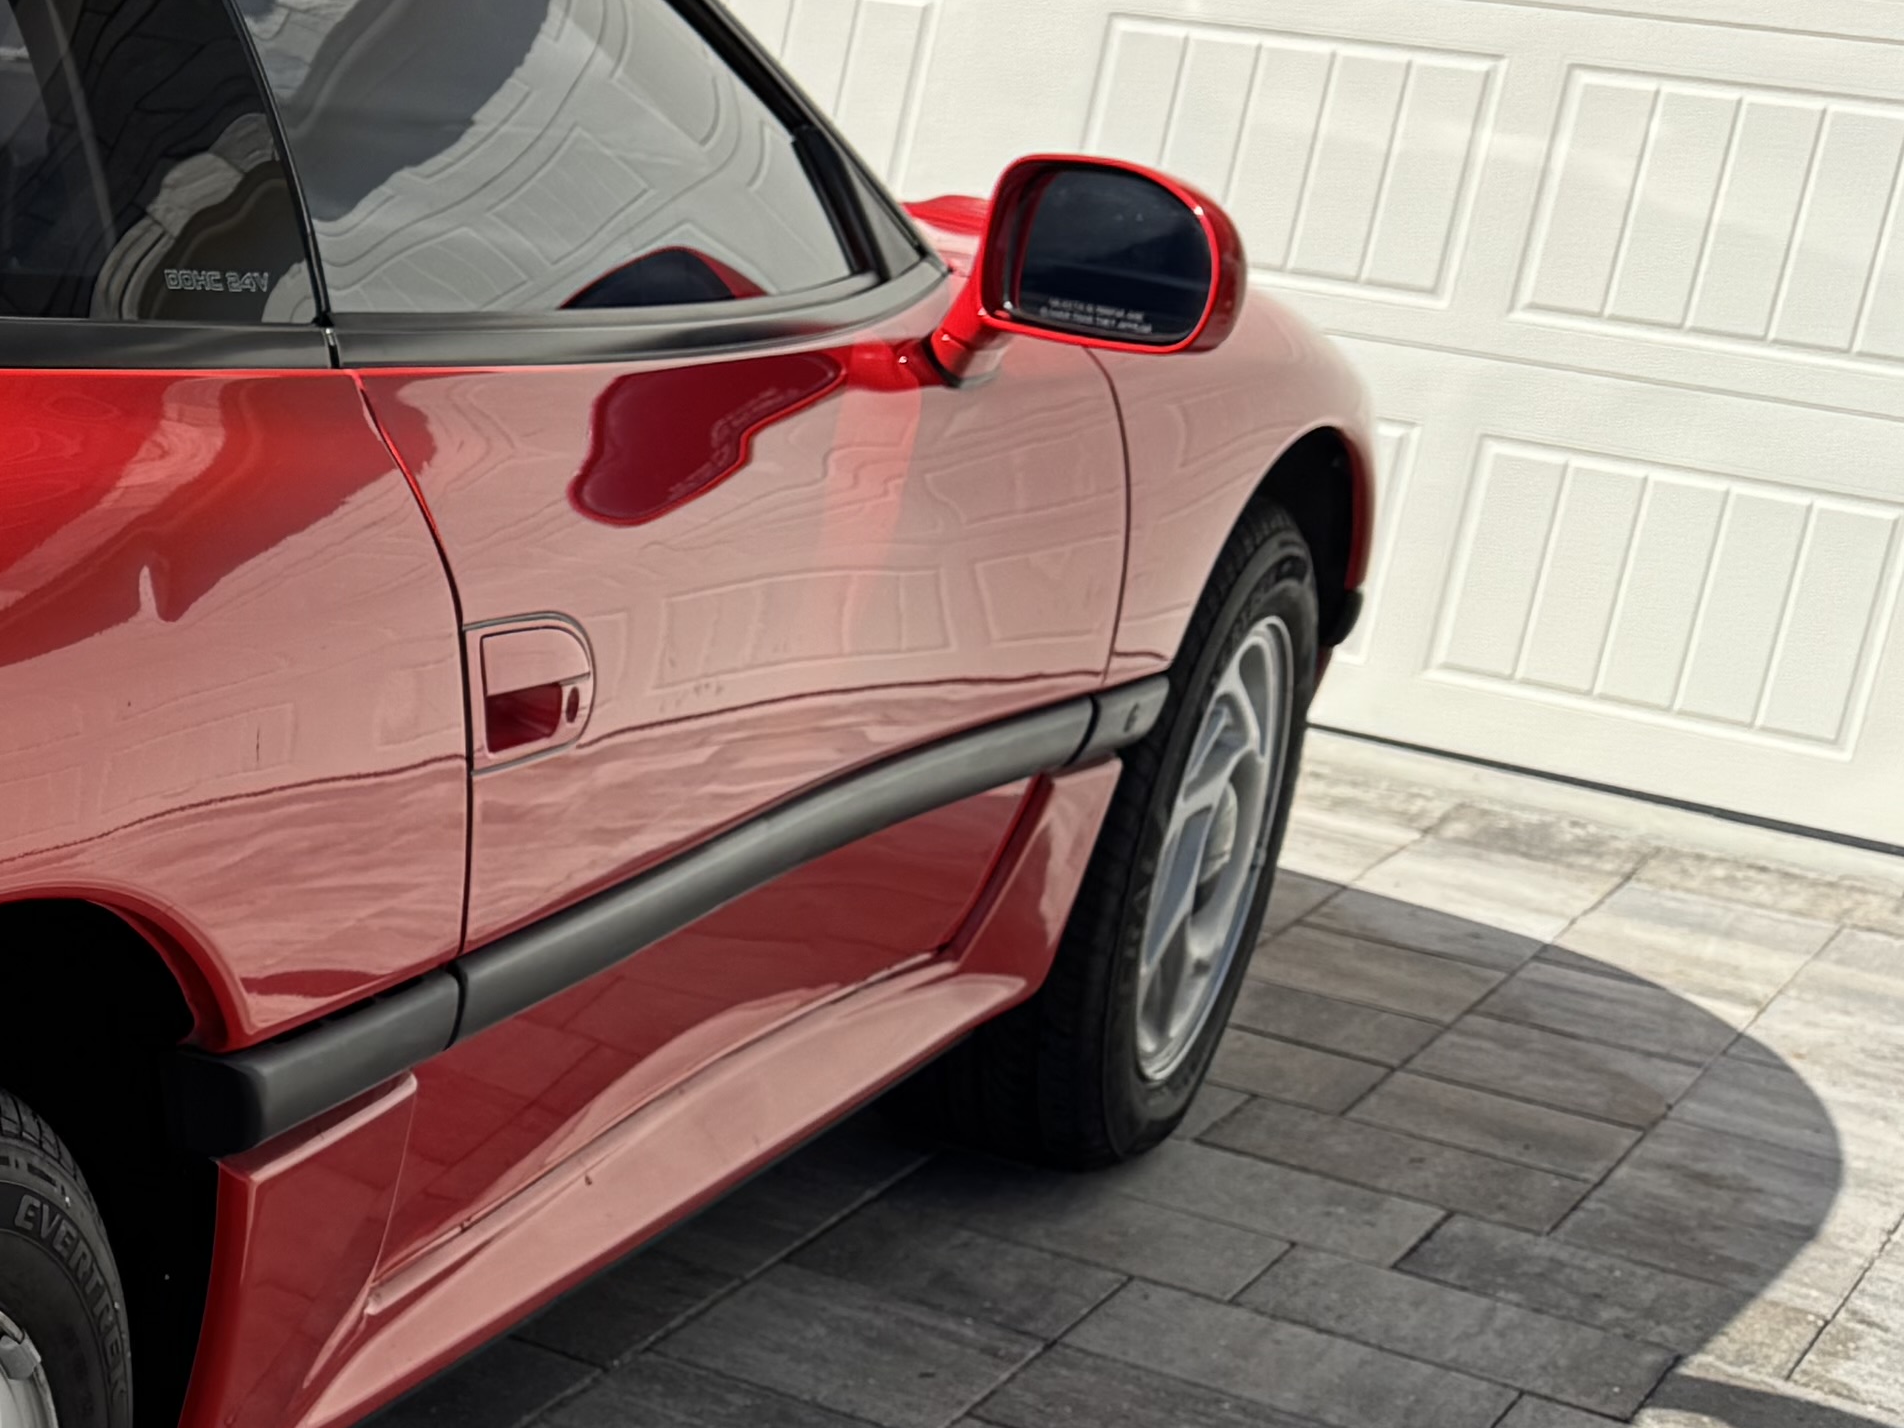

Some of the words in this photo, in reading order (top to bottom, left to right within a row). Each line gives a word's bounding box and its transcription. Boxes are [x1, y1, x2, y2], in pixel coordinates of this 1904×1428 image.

[164, 269, 224, 291] DOHC
[225, 271, 269, 292] 24V
[13, 1193, 131, 1403] EVERTREK
